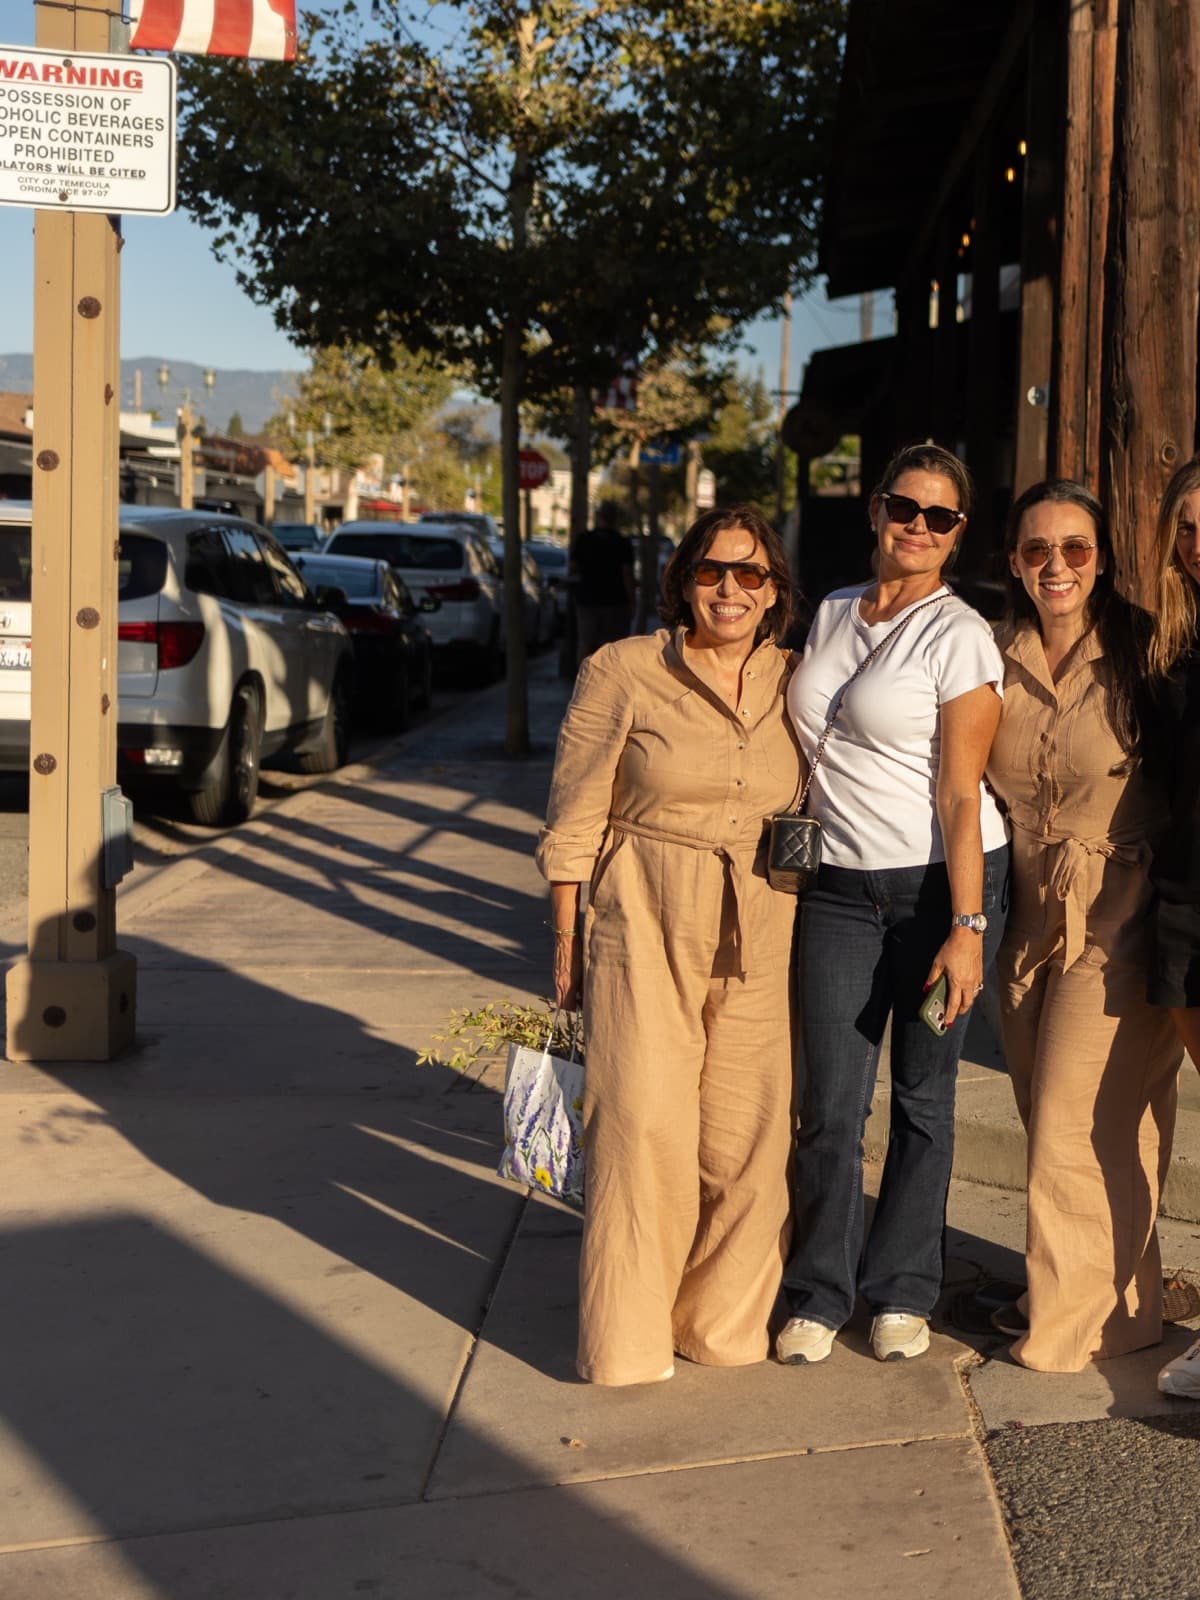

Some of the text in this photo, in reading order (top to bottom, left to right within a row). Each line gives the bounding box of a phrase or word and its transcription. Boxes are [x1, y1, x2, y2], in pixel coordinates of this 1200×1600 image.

[0, 59, 144, 89] WARNING
[0, 88, 132, 111] POSSESSION OF
[0, 106, 165, 131] OHOLIC BEVERAGES
[0, 124, 154, 148] OPEN CONTAINERS
[14, 143, 115, 163] PROHIBITED
[0, 160, 147, 178] LATORS WILL BE CITED
[17, 176, 111, 190] CITY OF TEMECULA
[20, 184, 79, 196] ORDINANCE
[519, 460, 547, 480] TOP
